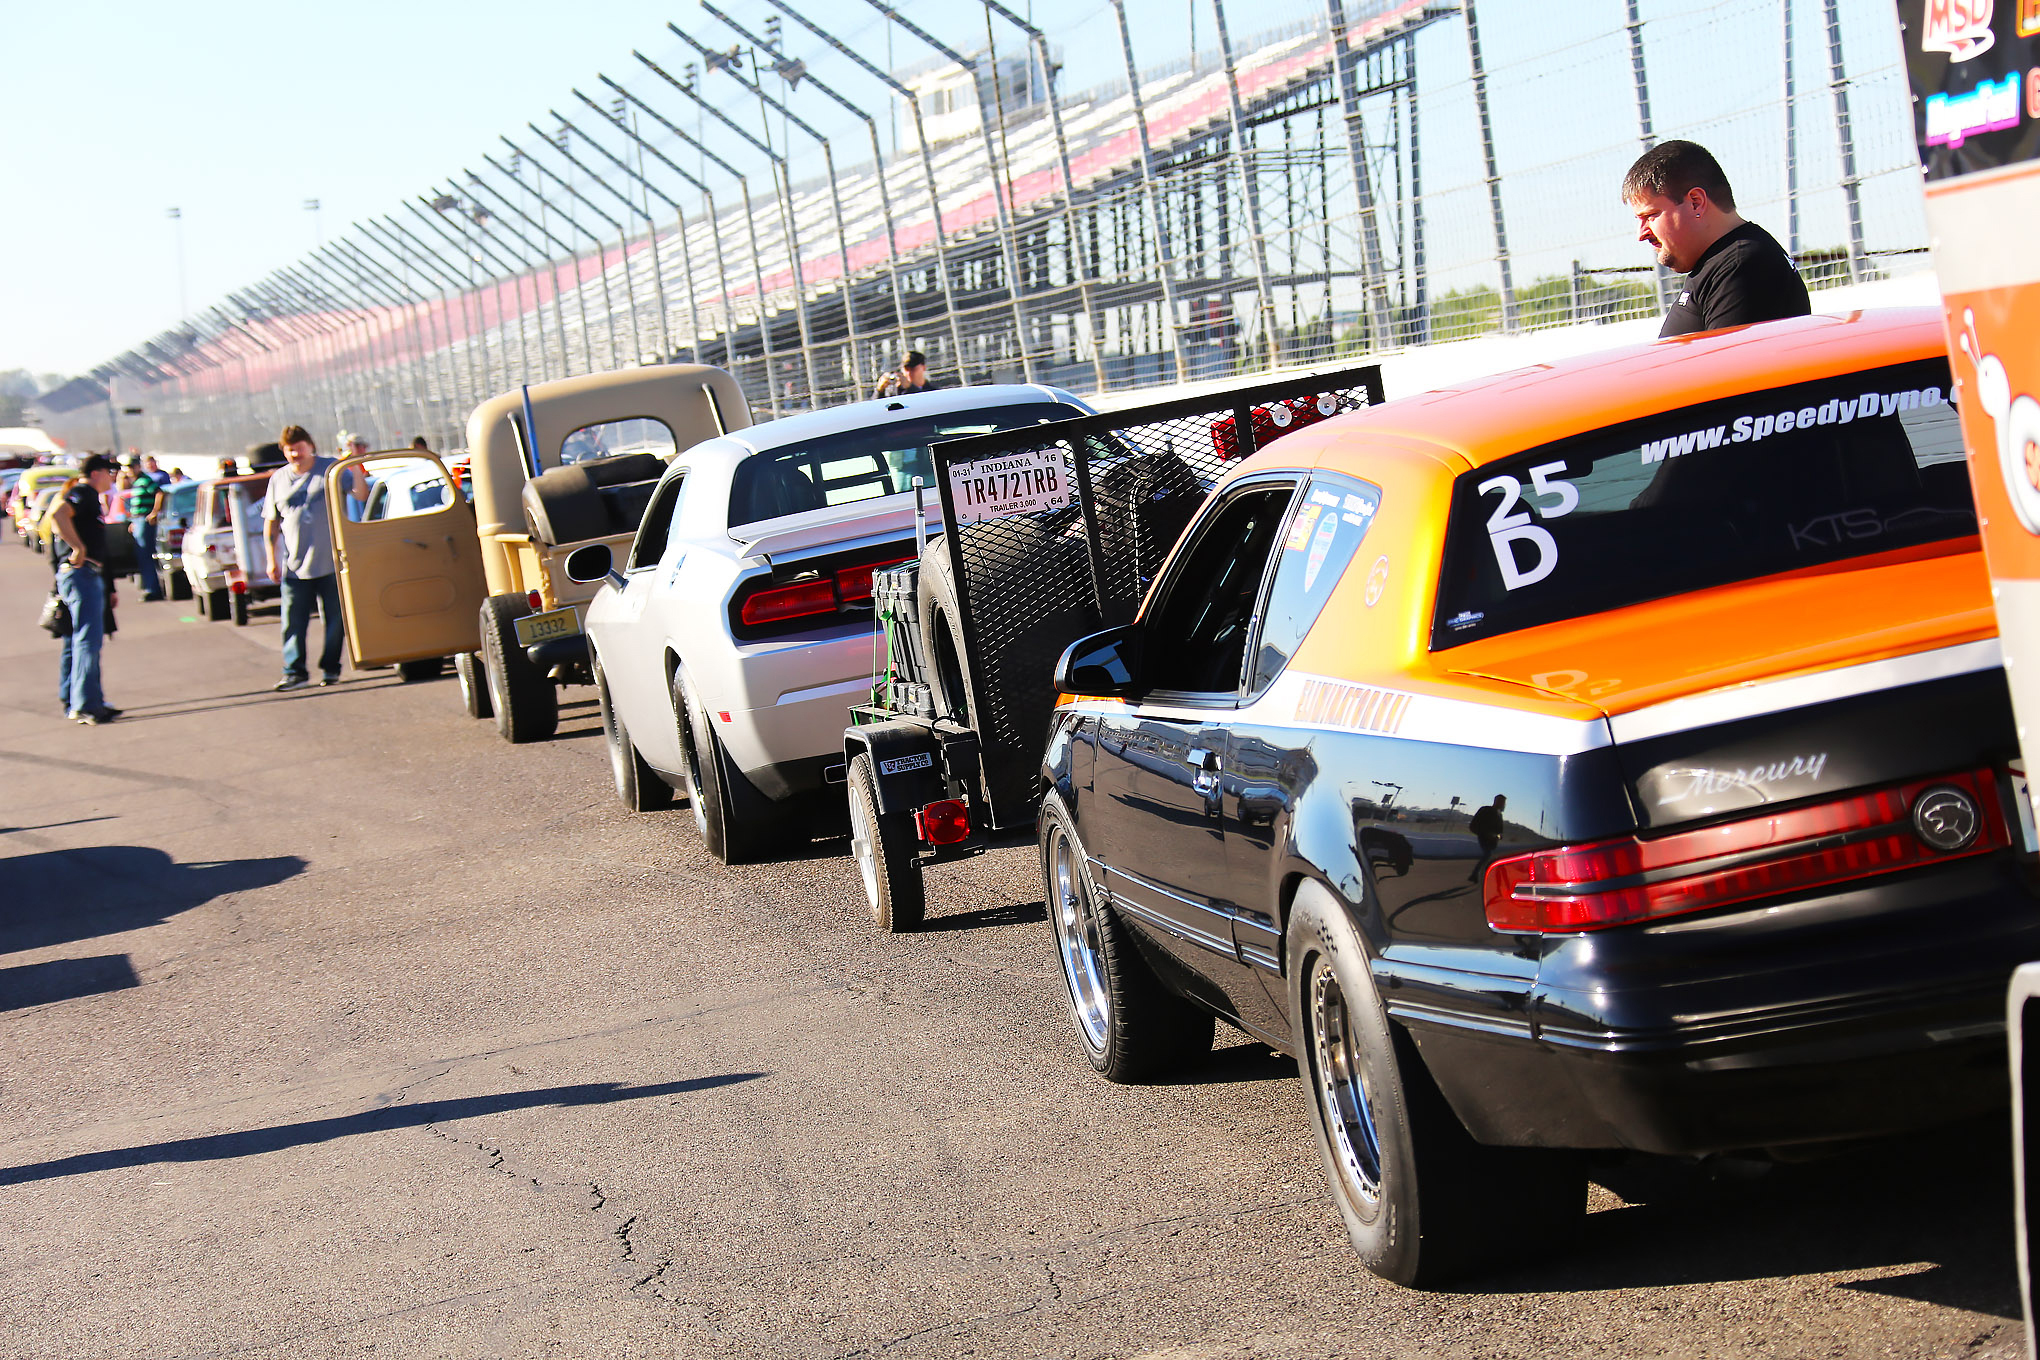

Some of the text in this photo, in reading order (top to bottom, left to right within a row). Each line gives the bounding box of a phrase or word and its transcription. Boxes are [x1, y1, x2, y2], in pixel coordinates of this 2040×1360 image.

[981, 457, 1033, 474] INDIANA
[1044, 453, 1057, 463] 16
[962, 466, 1058, 506] TR472TRB
[1050, 495, 1063, 505] 64
[1477, 460, 1580, 534] 25
[990, 501, 1019, 513] TRAILER
[1787, 508, 1883, 551] KTS
[1489, 524, 1559, 592] D
[529, 617, 566, 639] 13332
[896, 754, 928, 765] TRACTOR
[897, 762, 921, 772] SUPPLY
[1658, 753, 1827, 806] Mercury
